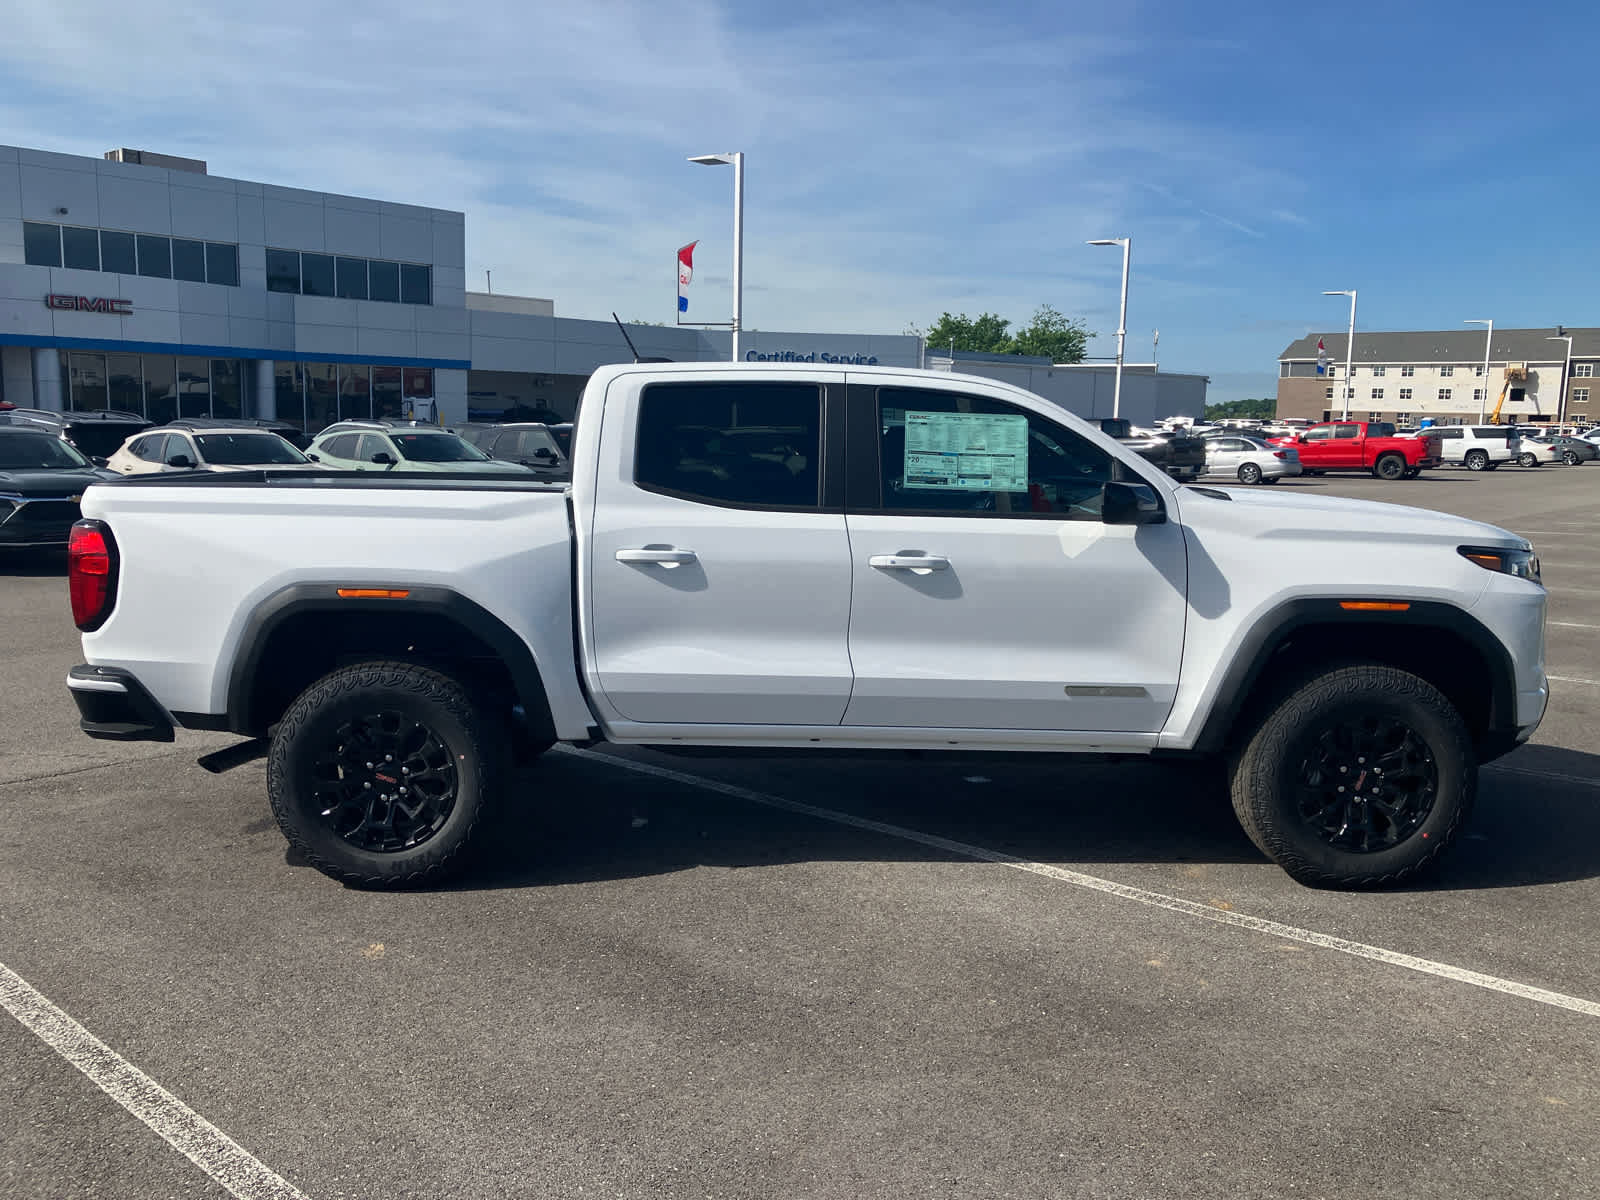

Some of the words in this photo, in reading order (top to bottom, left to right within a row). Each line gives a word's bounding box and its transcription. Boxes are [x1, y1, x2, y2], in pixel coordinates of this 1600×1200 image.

[44, 294, 133, 315] GMC
[746, 350, 815, 363] Certified
[821, 352, 878, 365] Service
